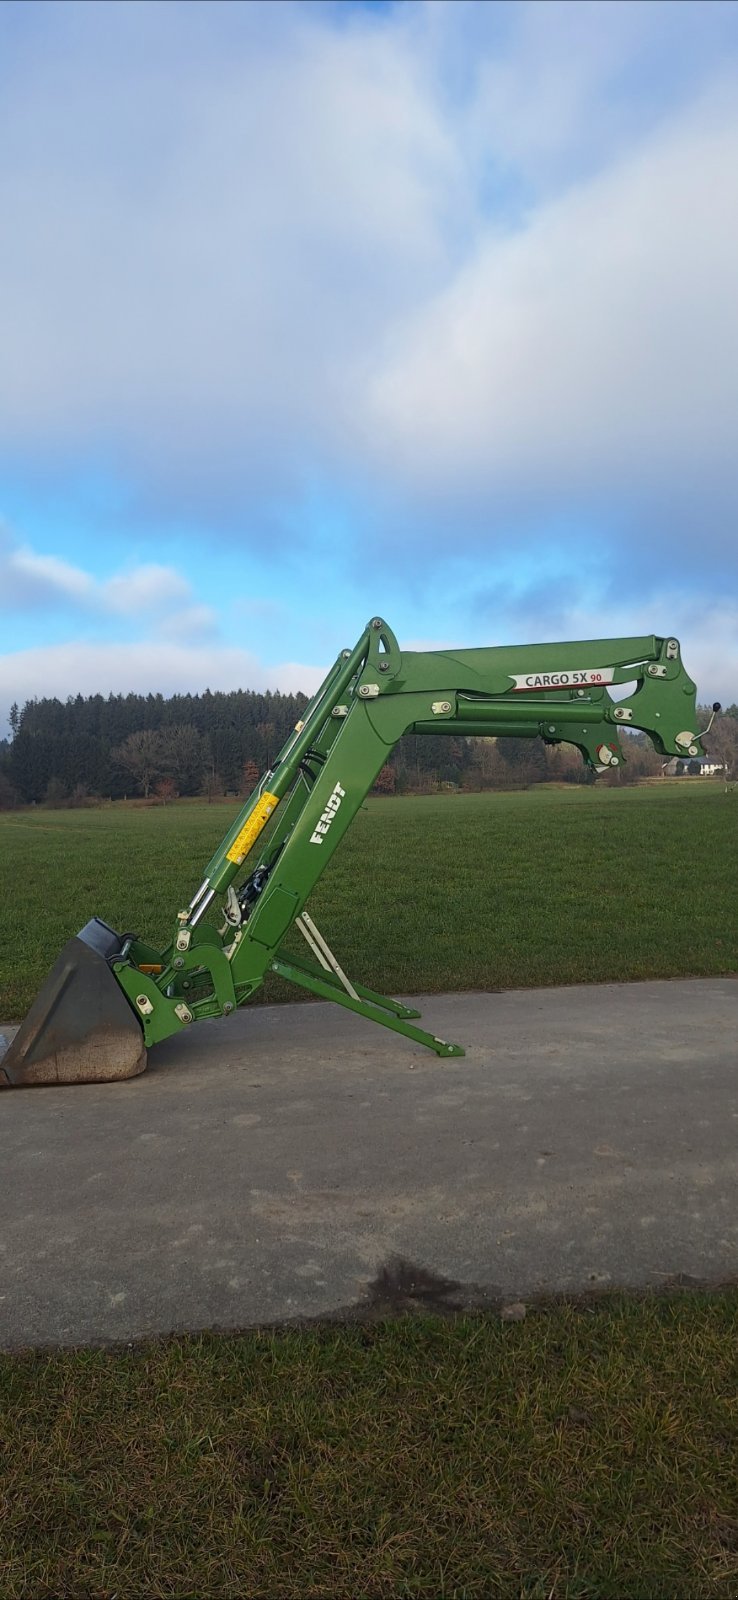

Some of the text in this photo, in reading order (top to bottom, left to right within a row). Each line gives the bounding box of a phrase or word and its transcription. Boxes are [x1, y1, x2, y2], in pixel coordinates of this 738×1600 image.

[525, 672, 602, 686] CARGO 5X 90
[309, 781, 345, 844] FENDT
